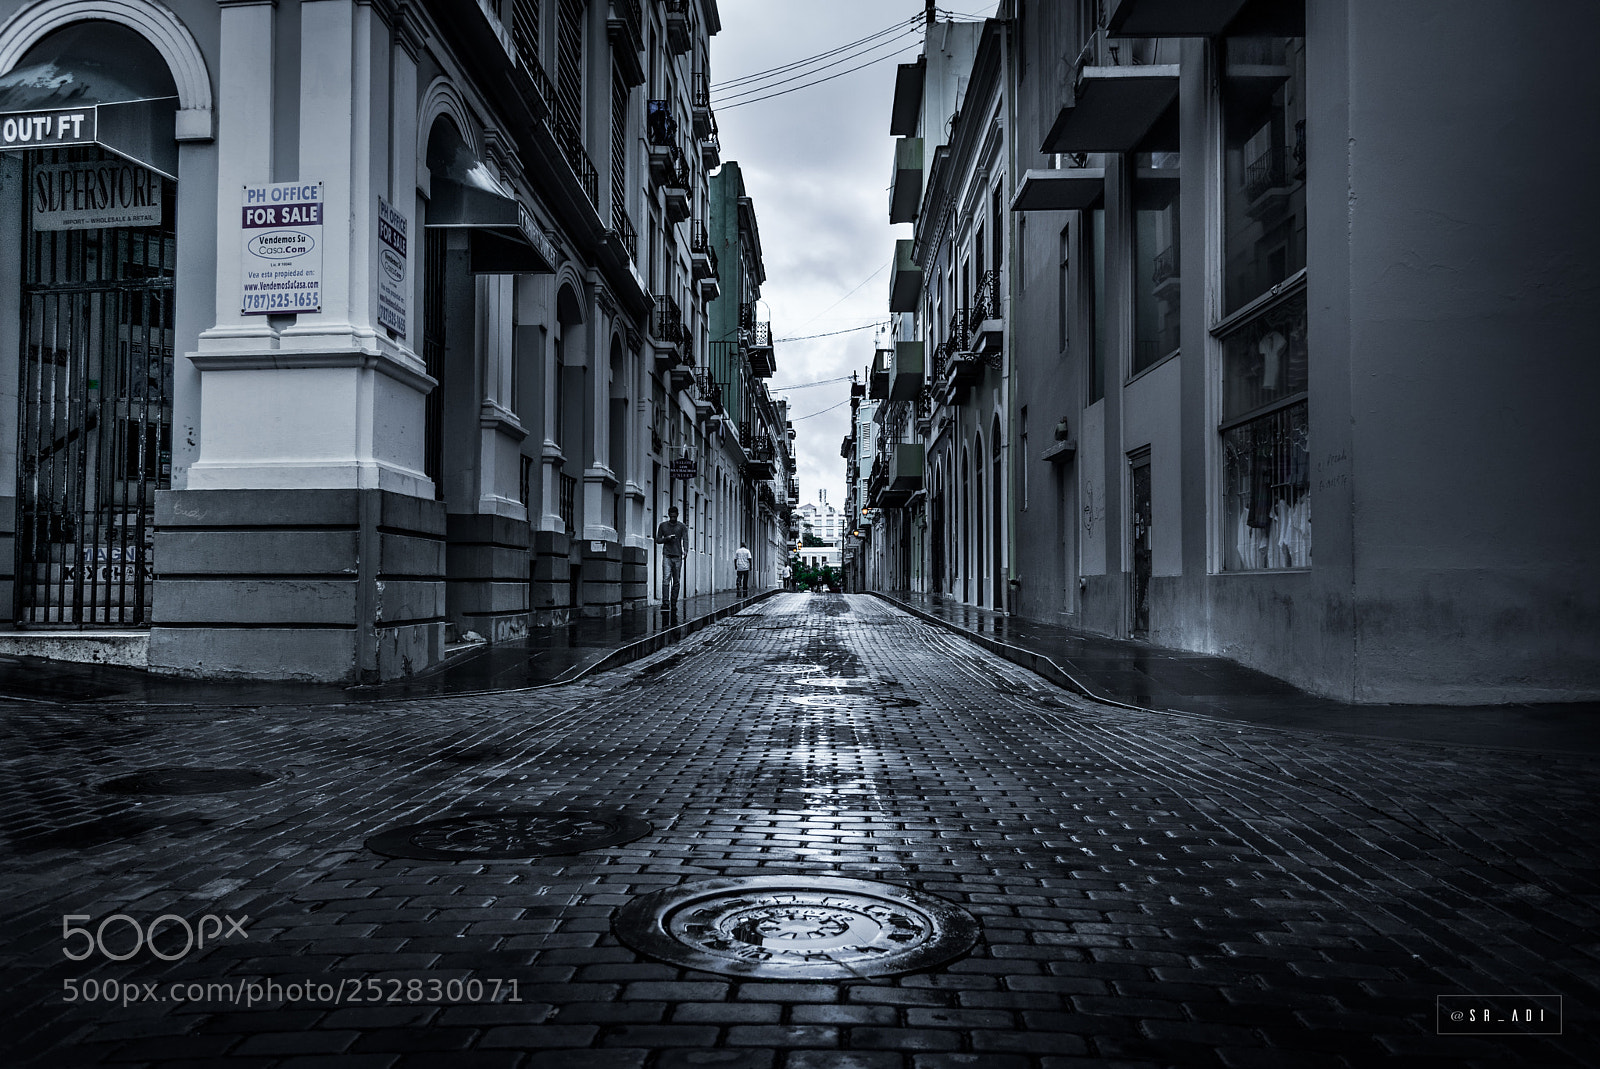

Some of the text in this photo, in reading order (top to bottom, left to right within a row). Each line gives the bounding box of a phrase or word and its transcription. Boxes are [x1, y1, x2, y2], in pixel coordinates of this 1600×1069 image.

[36, 165, 157, 213] SUPERSTORE
[248, 185, 317, 203] PH OFFICE
[91, 216, 126, 224] WHOLESALE
[246, 205, 318, 225] FOR SALE
[389, 208, 406, 235] OFFICE
[259, 234, 306, 245] Vendemos Su
[380, 221, 392, 244] FOR
[258, 245, 306, 255] Casa.Com
[248, 271, 260, 279] Vea
[274, 269, 304, 279] propiedad
[243, 280, 319, 291] www.VendemosSuCasa.com
[243, 291, 319, 311] (787)525-1655
